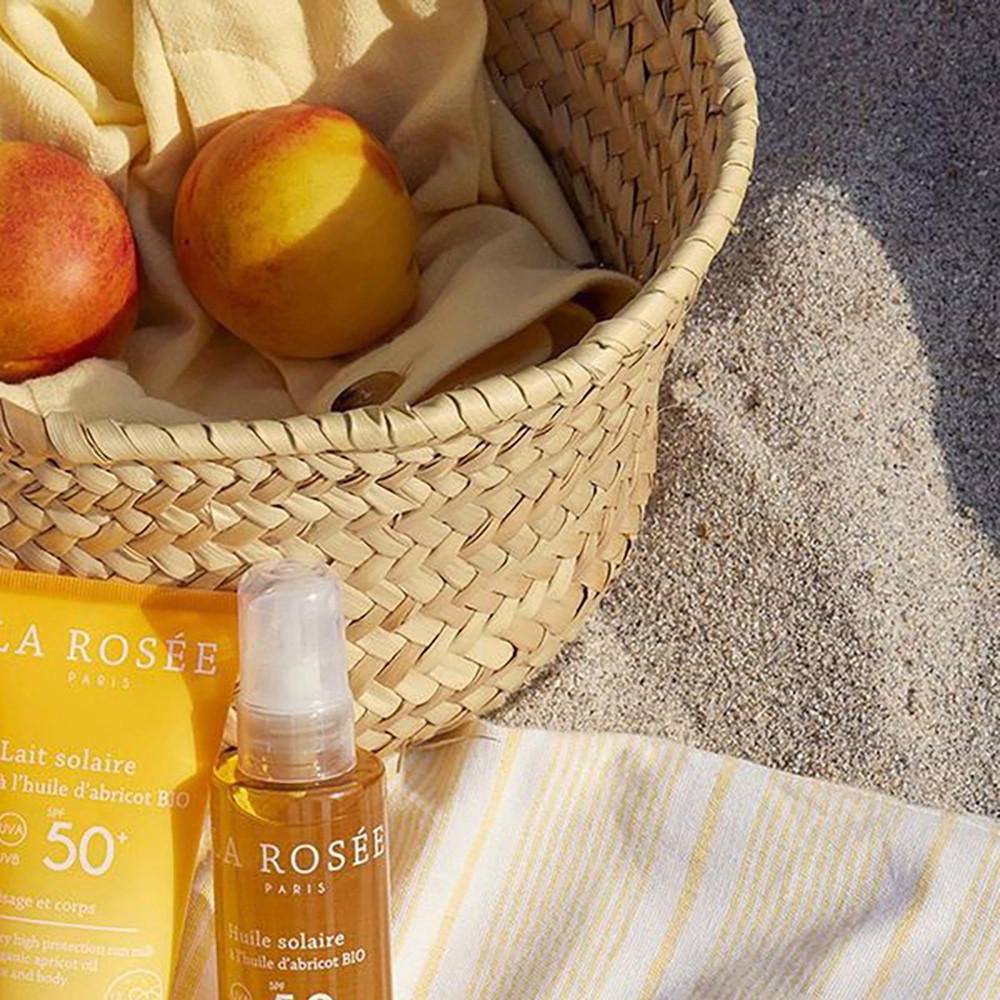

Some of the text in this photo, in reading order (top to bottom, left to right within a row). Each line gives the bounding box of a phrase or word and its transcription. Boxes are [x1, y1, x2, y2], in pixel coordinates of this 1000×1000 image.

[67, 628, 218, 676] ROSÉE
[68, 672, 131, 689] PARIS
[0, 740, 137, 775] Lait solaire
[12, 775, 68, 797] l'huile
[74, 782, 151, 806] d'abricot
[157, 790, 190, 808] BIO
[215, 824, 386, 874] A ROSÉE
[264, 882, 326, 894] PARIS
[36, 894, 51, 908] et
[55, 898, 96, 915] corps
[228, 923, 345, 951] Huile solaire
[33, 956, 78, 971] apricot
[277, 956, 340, 971] d'abricot
[342, 948, 366, 966] BIO
[36, 970, 68, 986] body
